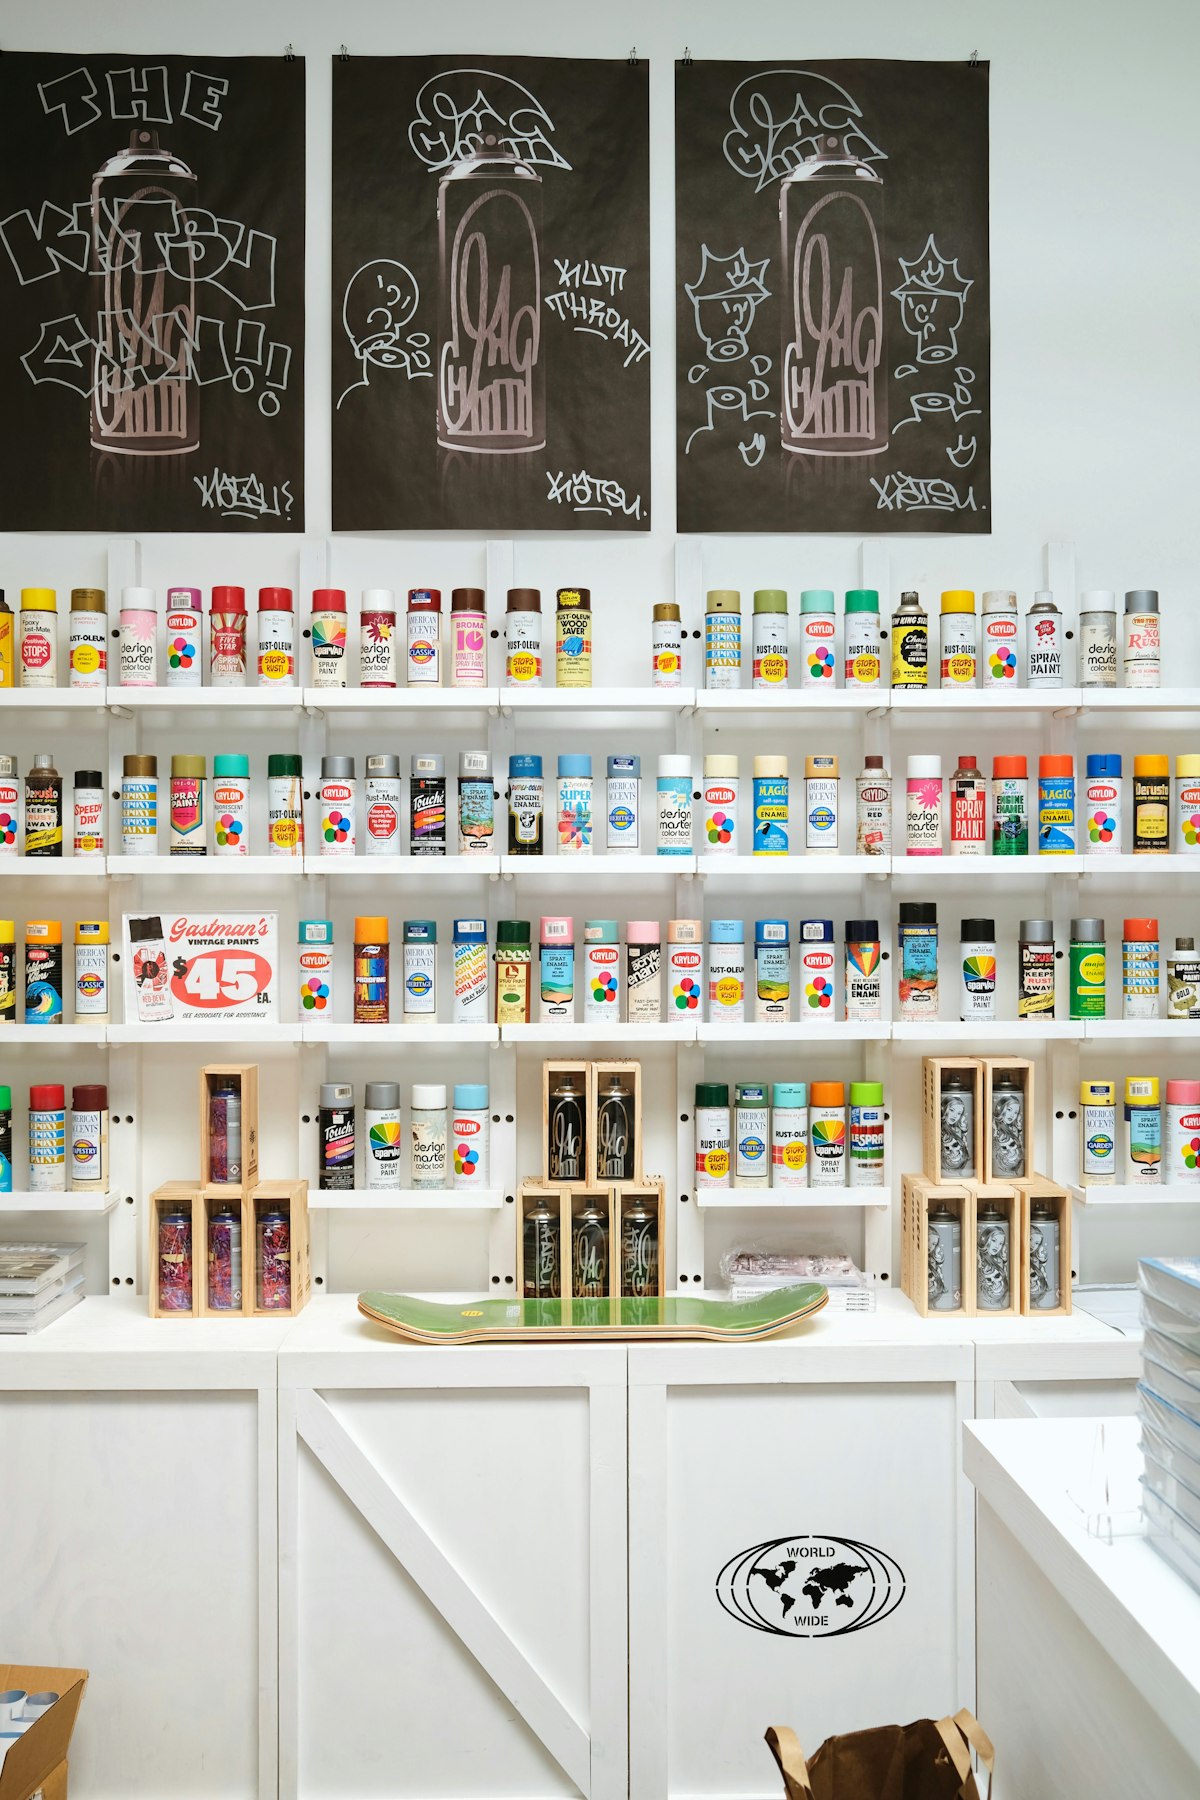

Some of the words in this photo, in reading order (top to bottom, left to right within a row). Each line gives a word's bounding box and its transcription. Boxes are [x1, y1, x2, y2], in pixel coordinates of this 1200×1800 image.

[37, 66, 229, 136] THE
[168, 617, 194, 627] KRYLON
[561, 620, 587, 628] WOOD
[900, 617, 916, 625] KING
[808, 624, 834, 634] KRYLON
[990, 624, 1015, 634] KRYLON
[219, 636, 236, 644] FIVE
[121, 643, 152, 654] design
[259, 642, 292, 651] RUST-OLEUM
[508, 641, 540, 650] RUST-OLEUM
[23, 646, 47, 657] STOPS
[711, 650, 738, 658] EPOXY
[121, 655, 153, 664] master
[217, 656, 240, 664] SPRAY
[265, 655, 285, 664] STOPS
[513, 657, 534, 666] STOPS
[711, 658, 739, 666] PAINT
[951, 659, 972, 667] STOPS
[1031, 653, 1061, 664] SPRAY
[218, 664, 237, 672] PAINT
[856, 660, 876, 668] STOPS
[266, 665, 285, 673] RUST!
[515, 666, 533, 674] RUST!
[765, 668, 783, 676] RUST!
[858, 668, 875, 677] RUST!
[953, 668, 971, 676] RUST!
[1031, 665, 1061, 674] PAINT
[26, 785, 58, 799] Derusto
[323, 789, 348, 798] KRYLON
[759, 785, 788, 796] MAGIC
[862, 789, 888, 799] KRYLON
[1041, 788, 1072, 800] MAGIC
[1088, 789, 1114, 798] KRYLON
[171, 791, 200, 801] SPRAY
[216, 792, 240, 801] KRYLON
[366, 794, 399, 802] Rust-Mate
[413, 792, 444, 808] Touché
[560, 791, 591, 800] SUPER
[707, 791, 732, 800] KRYLON
[997, 796, 1024, 804] ENGINE
[122, 801, 151, 809] EPOXY
[172, 799, 198, 808] PAINT
[564, 801, 588, 811] FLAT
[74, 803, 102, 815] SPEEDY
[956, 800, 982, 819] SPRAY
[997, 805, 1024, 813] ENAMEL
[660, 809, 691, 820] design
[908, 811, 938, 822] design
[80, 815, 100, 825] DRY
[122, 818, 151, 826] EPOXY
[275, 824, 296, 832] STOPS
[660, 821, 691, 829] master
[907, 823, 938, 831] master
[956, 820, 983, 838] PAINT
[122, 826, 151, 834] PAINT
[277, 833, 294, 841] RUST!
[170, 918, 268, 942] Gastman's
[188, 938, 225, 946] VINTAGE
[302, 956, 327, 965] KRYLON
[591, 952, 617, 960] KRYLON
[674, 955, 699, 964] KRYLON
[26, 959, 56, 972] California
[806, 956, 832, 966] KRYLON
[461, 993, 475, 1004] SPRAY
[475, 984, 487, 996] PAINT
[1127, 986, 1156, 994] PAINT
[1176, 988, 1190, 999] GOLD
[257, 992, 271, 1004] EA.
[30, 1114, 57, 1122] EPOXY
[30, 1122, 57, 1130] EPOXY
[30, 1130, 57, 1138] EPOXY
[30, 1138, 57, 1146] EPOXY
[30, 1147, 57, 1155] EPOXY
[414, 1142, 445, 1152] design
[30, 1155, 59, 1163] PAINT
[414, 1153, 445, 1161] master
[708, 1155, 727, 1163] STOPS
[710, 1163, 726, 1171] RUST!
[786, 1547, 834, 1558] WORLD
[794, 1616, 828, 1626] WIDE
